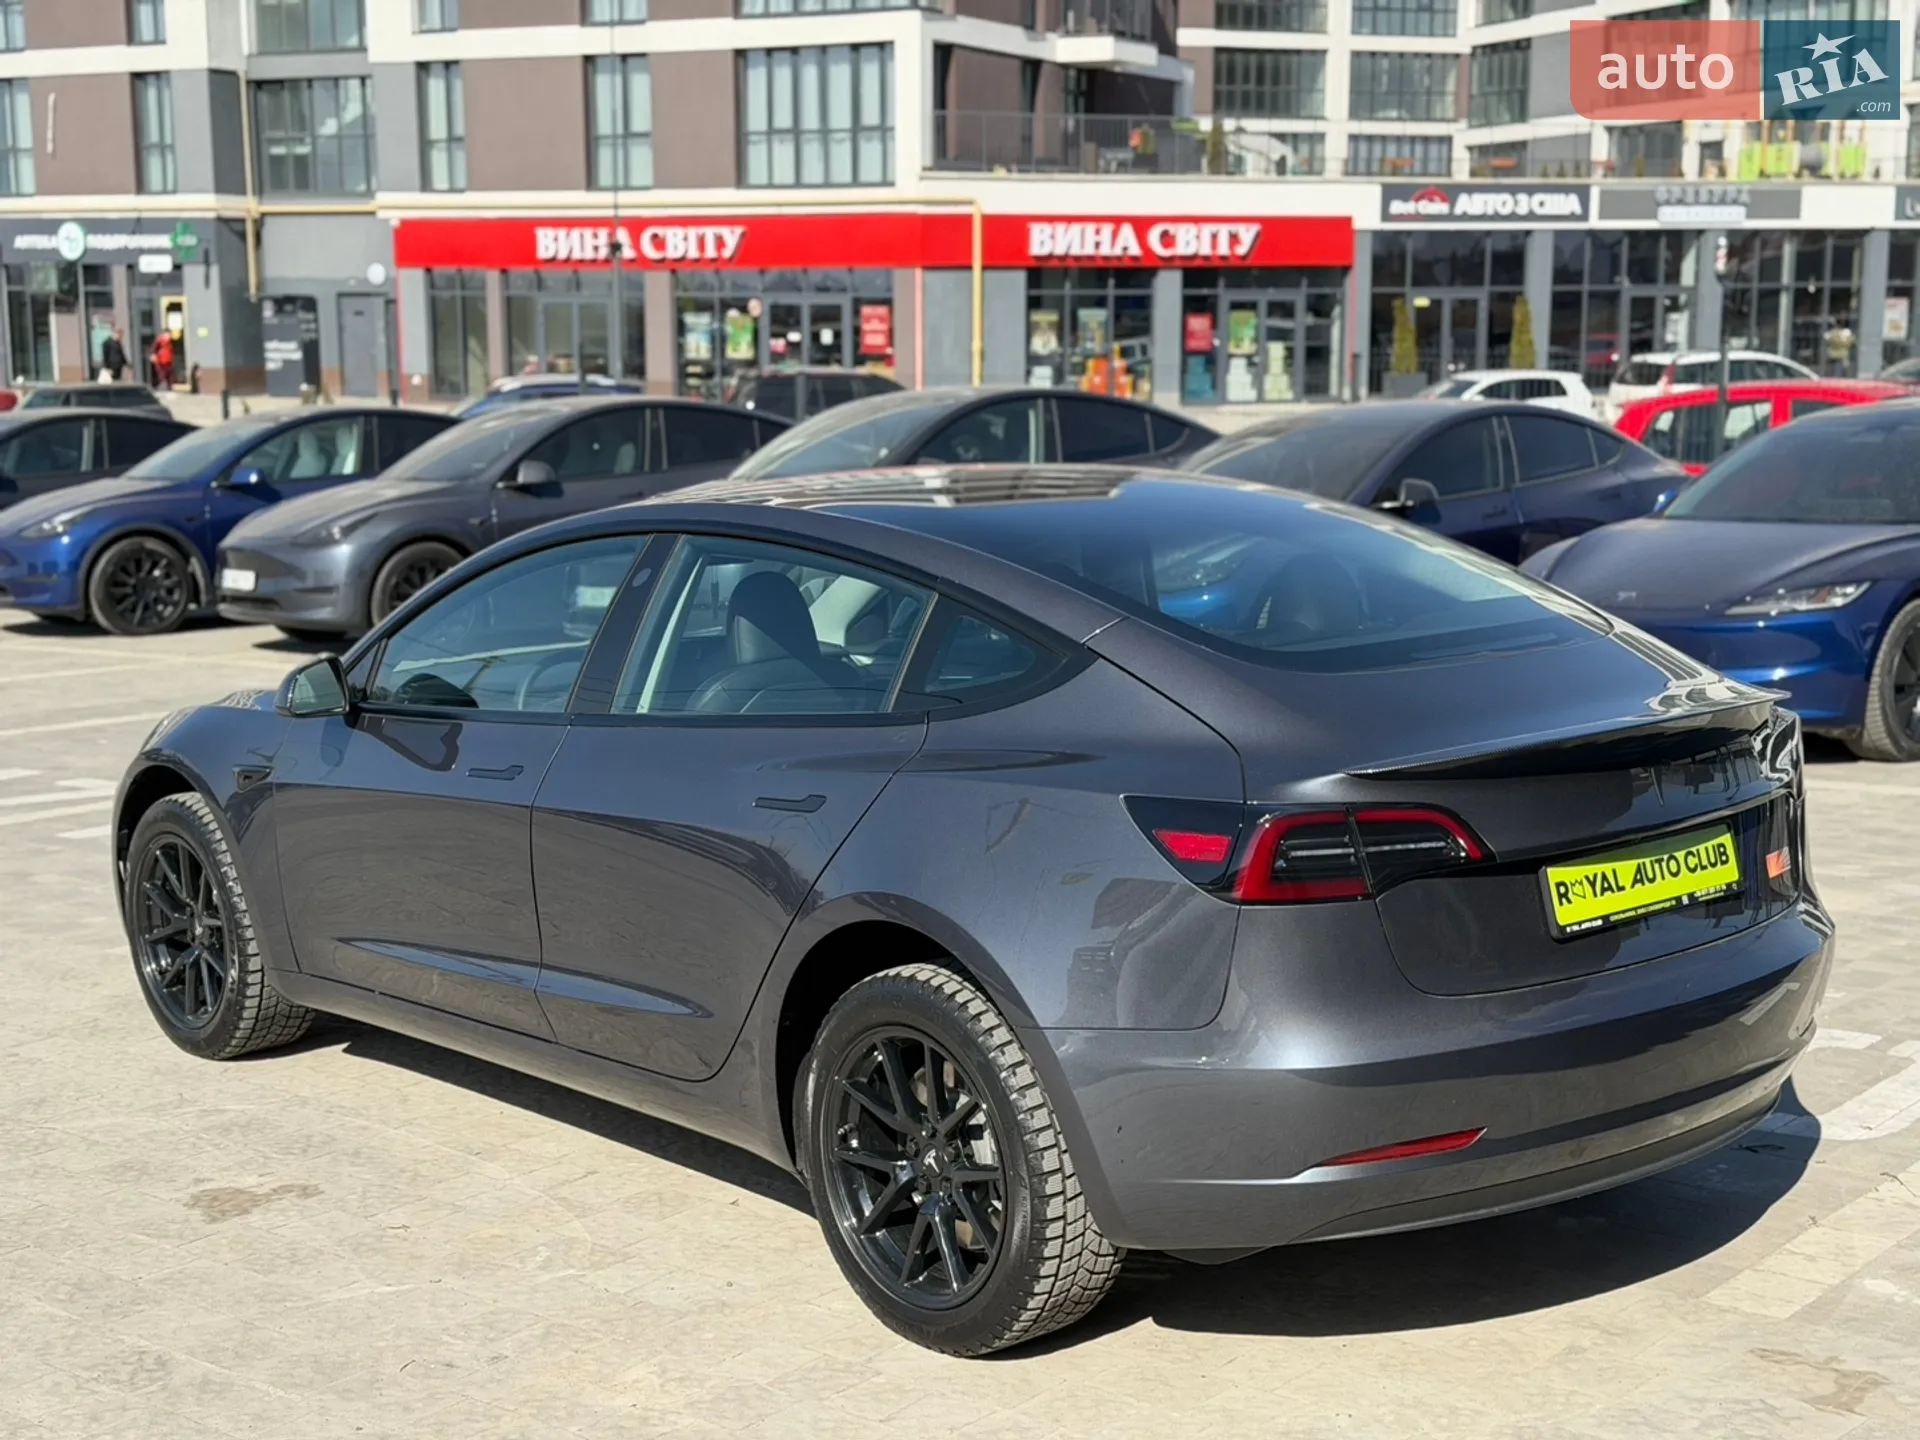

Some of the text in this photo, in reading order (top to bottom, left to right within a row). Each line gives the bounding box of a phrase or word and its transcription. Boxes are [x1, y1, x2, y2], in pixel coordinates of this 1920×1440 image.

[1453, 192, 1515, 216] АВТО
[1531, 192, 1583, 216] США
[534, 225, 747, 261] ВИНА СВІТУ
[1028, 222, 1262, 257] ВИНА СВІТУ
[1630, 853, 1681, 889] AUTO
[1683, 842, 1730, 874] CLUB
